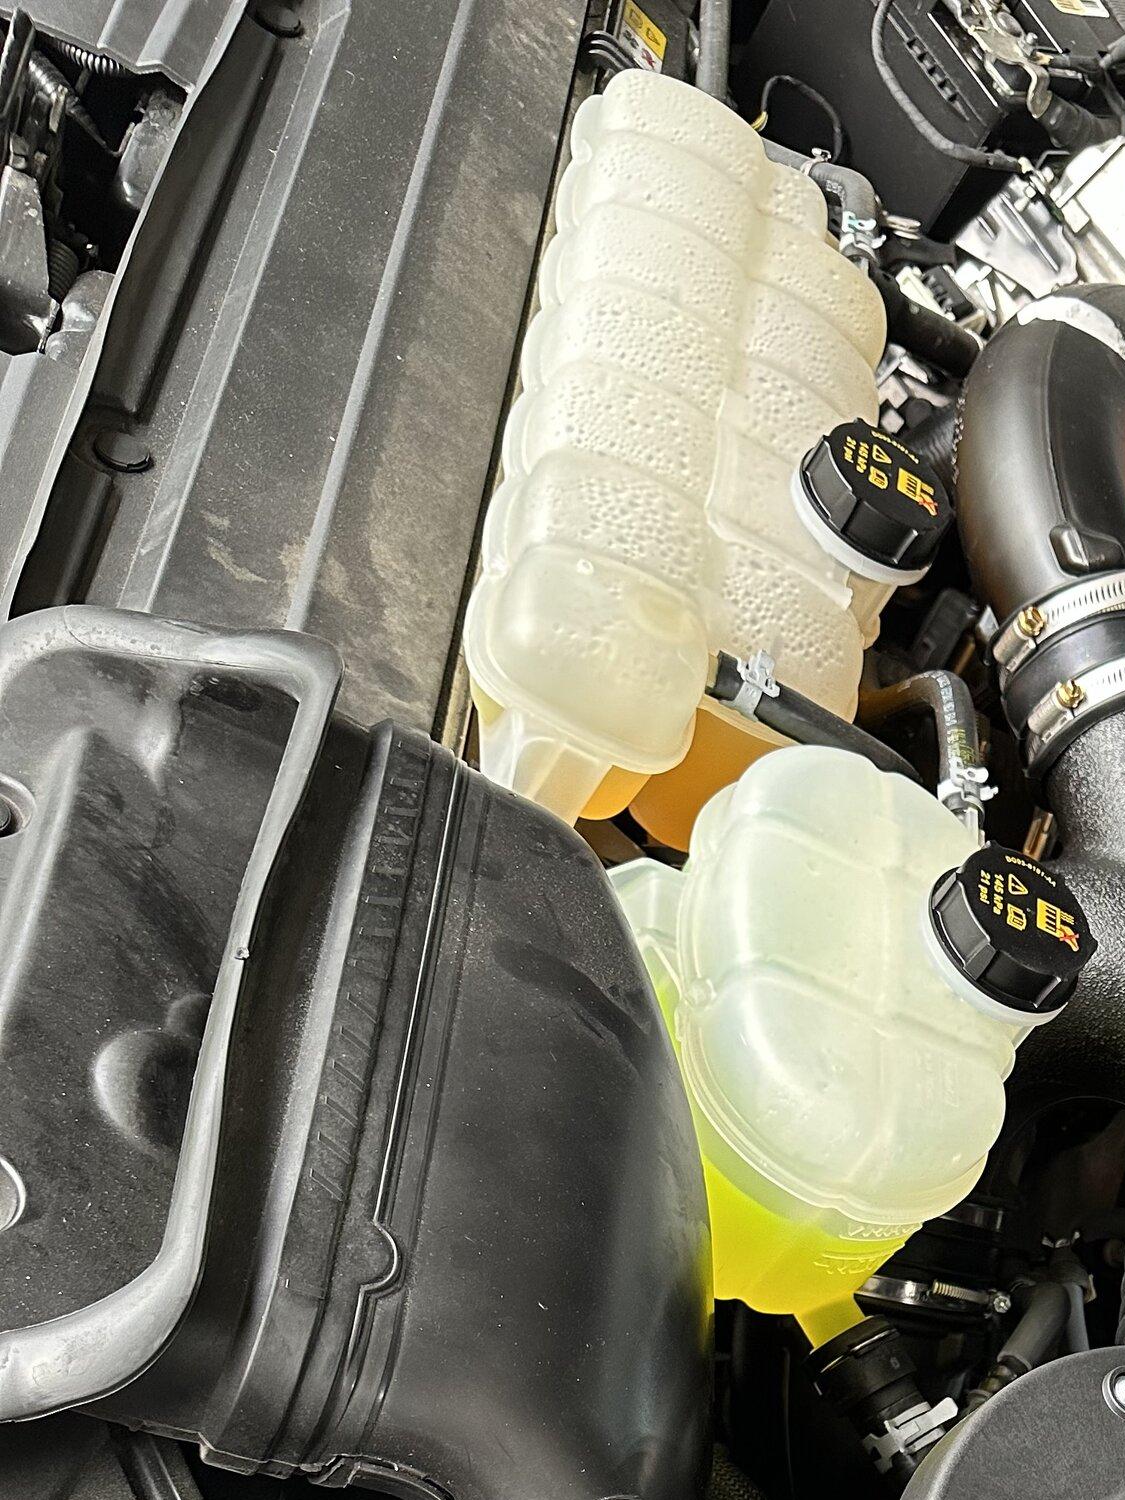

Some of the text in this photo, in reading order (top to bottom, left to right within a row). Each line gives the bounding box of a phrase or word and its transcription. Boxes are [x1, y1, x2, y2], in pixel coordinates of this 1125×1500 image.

[978, 869, 991, 905] 21 psi
[992, 873, 1005, 915] 145 kPa
